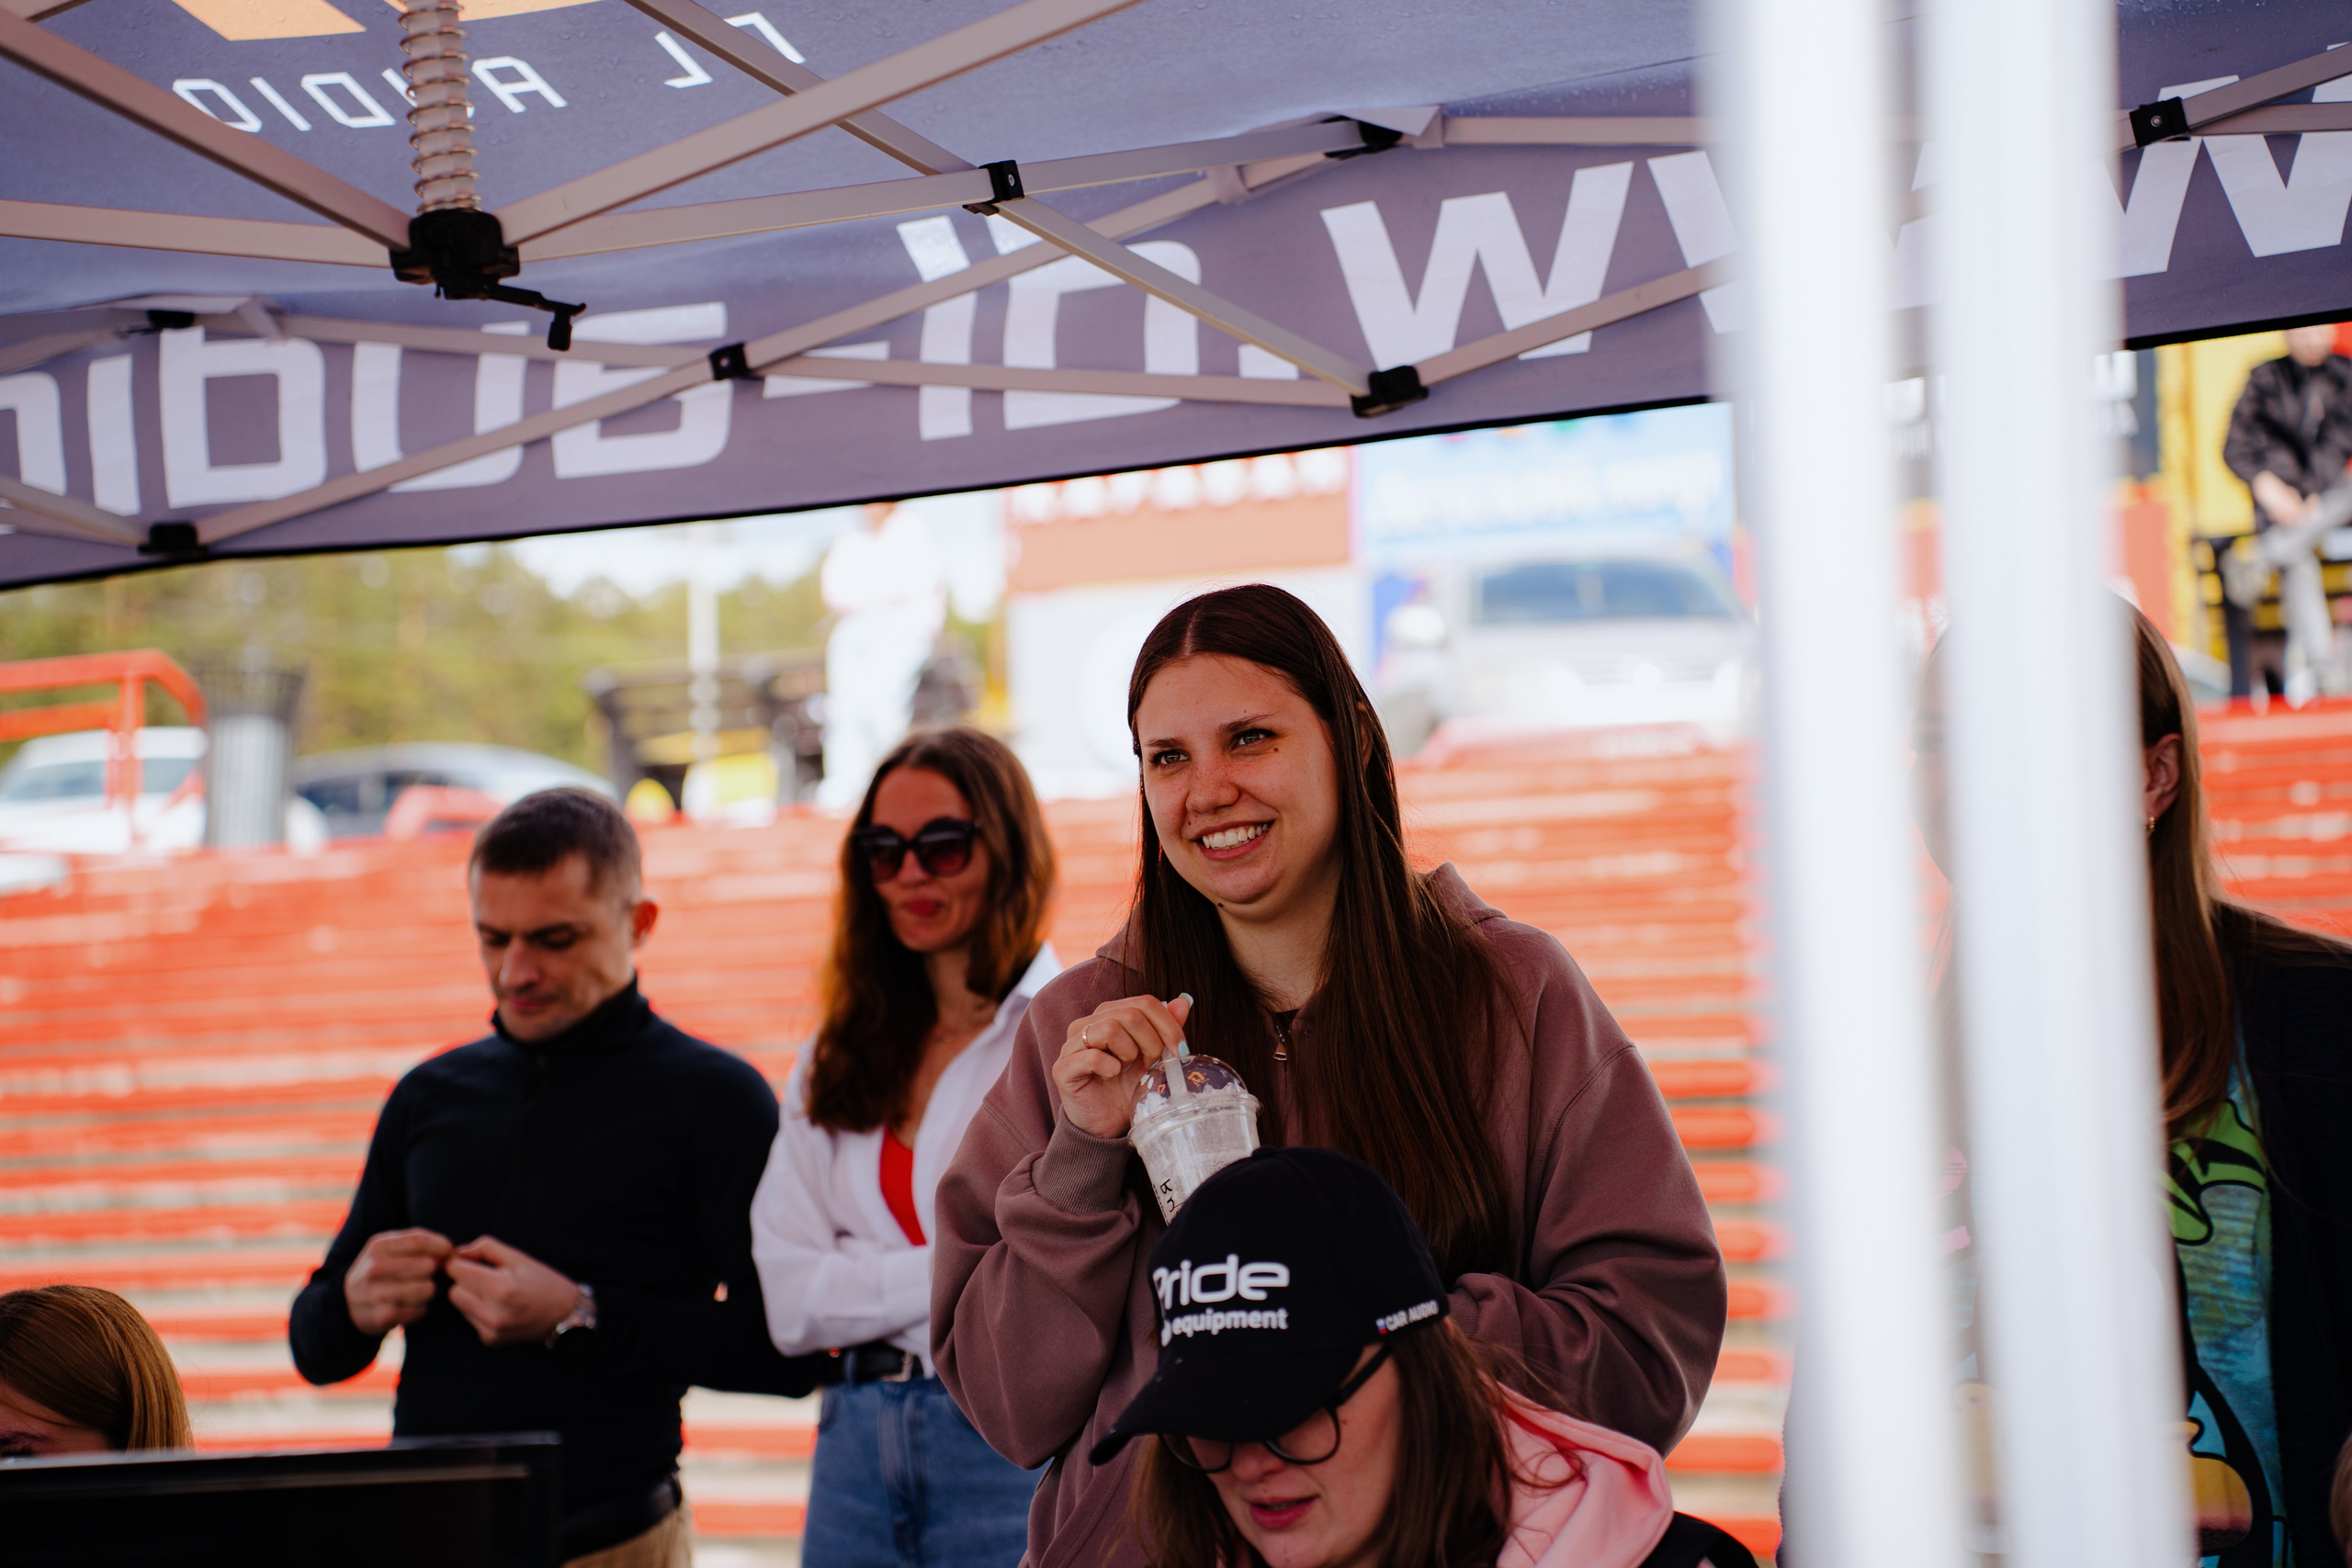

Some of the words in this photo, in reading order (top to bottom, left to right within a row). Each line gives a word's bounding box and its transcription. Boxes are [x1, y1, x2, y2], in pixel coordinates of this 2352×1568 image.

[1171, 1307, 1289, 1337] equipment
[1385, 1310, 1408, 1332] CAR
[1408, 1300, 1440, 1323] AUDIO
